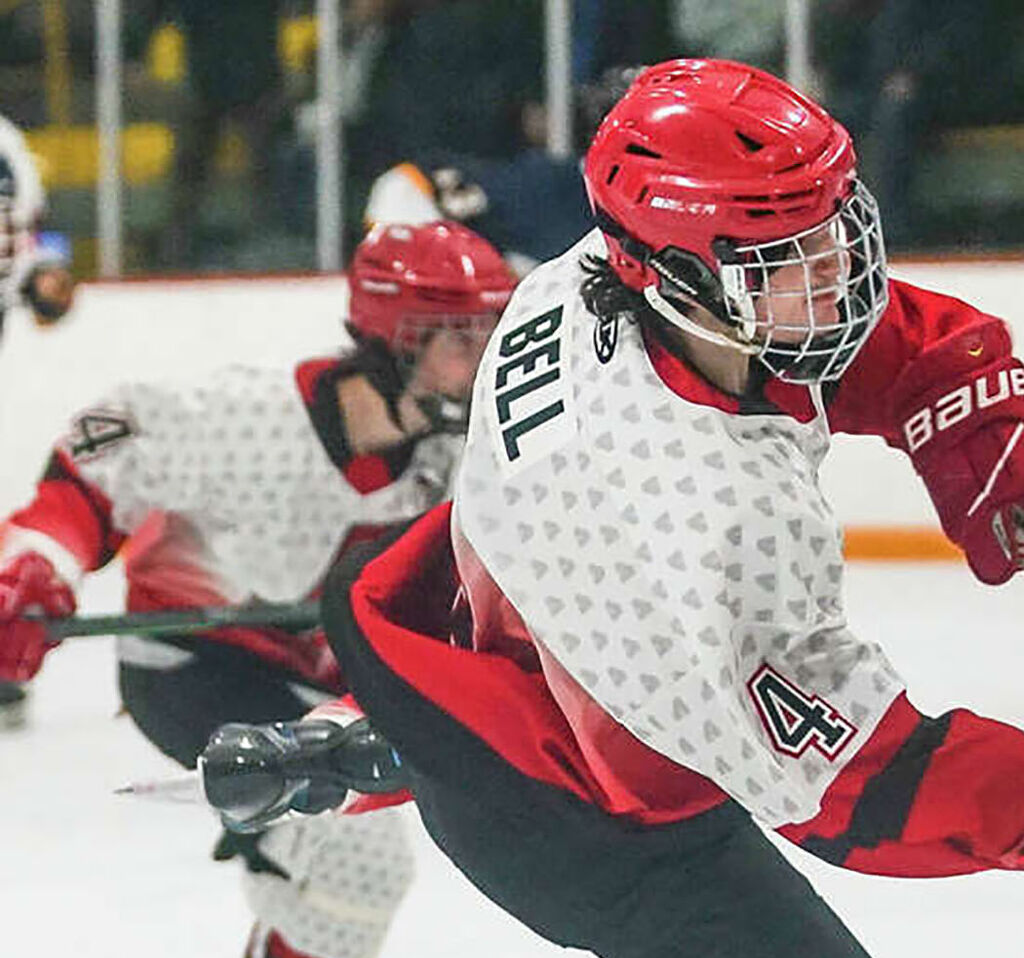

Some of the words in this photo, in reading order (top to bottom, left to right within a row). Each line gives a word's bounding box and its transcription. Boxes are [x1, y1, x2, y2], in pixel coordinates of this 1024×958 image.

[495, 304, 565, 462] BELL
[70, 409, 137, 463] 4
[746, 661, 858, 763] 4
